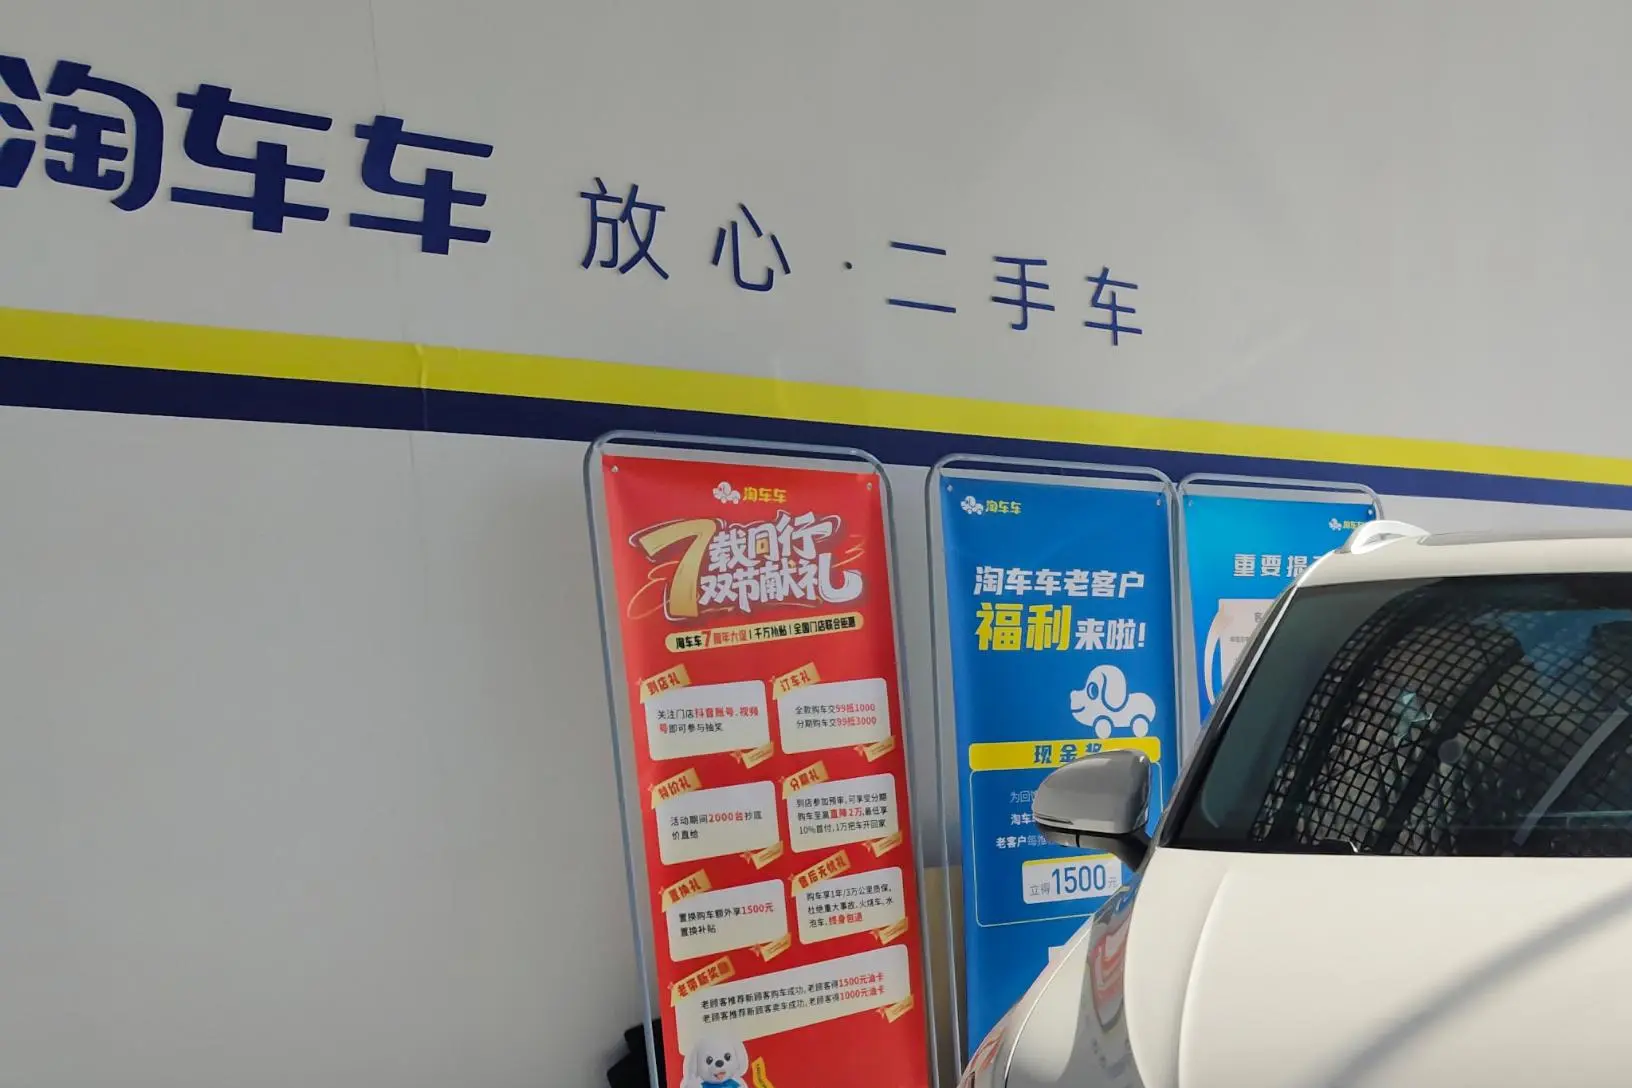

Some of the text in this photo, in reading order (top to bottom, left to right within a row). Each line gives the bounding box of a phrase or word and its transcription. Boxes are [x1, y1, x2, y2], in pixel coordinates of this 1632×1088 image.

[0, 55, 493, 255] 淘车车
[743, 486, 787, 503] 淘车车
[985, 500, 1022, 515] 淘车车
[1233, 553, 1323, 578] 重要提
[699, 553, 863, 613] 双节献礼
[973, 566, 1145, 598] 淘车车老客户
[647, 671, 680, 696] 到店礼
[780, 669, 811, 692] 订车礼
[680, 924, 717, 937] 置换补贴
